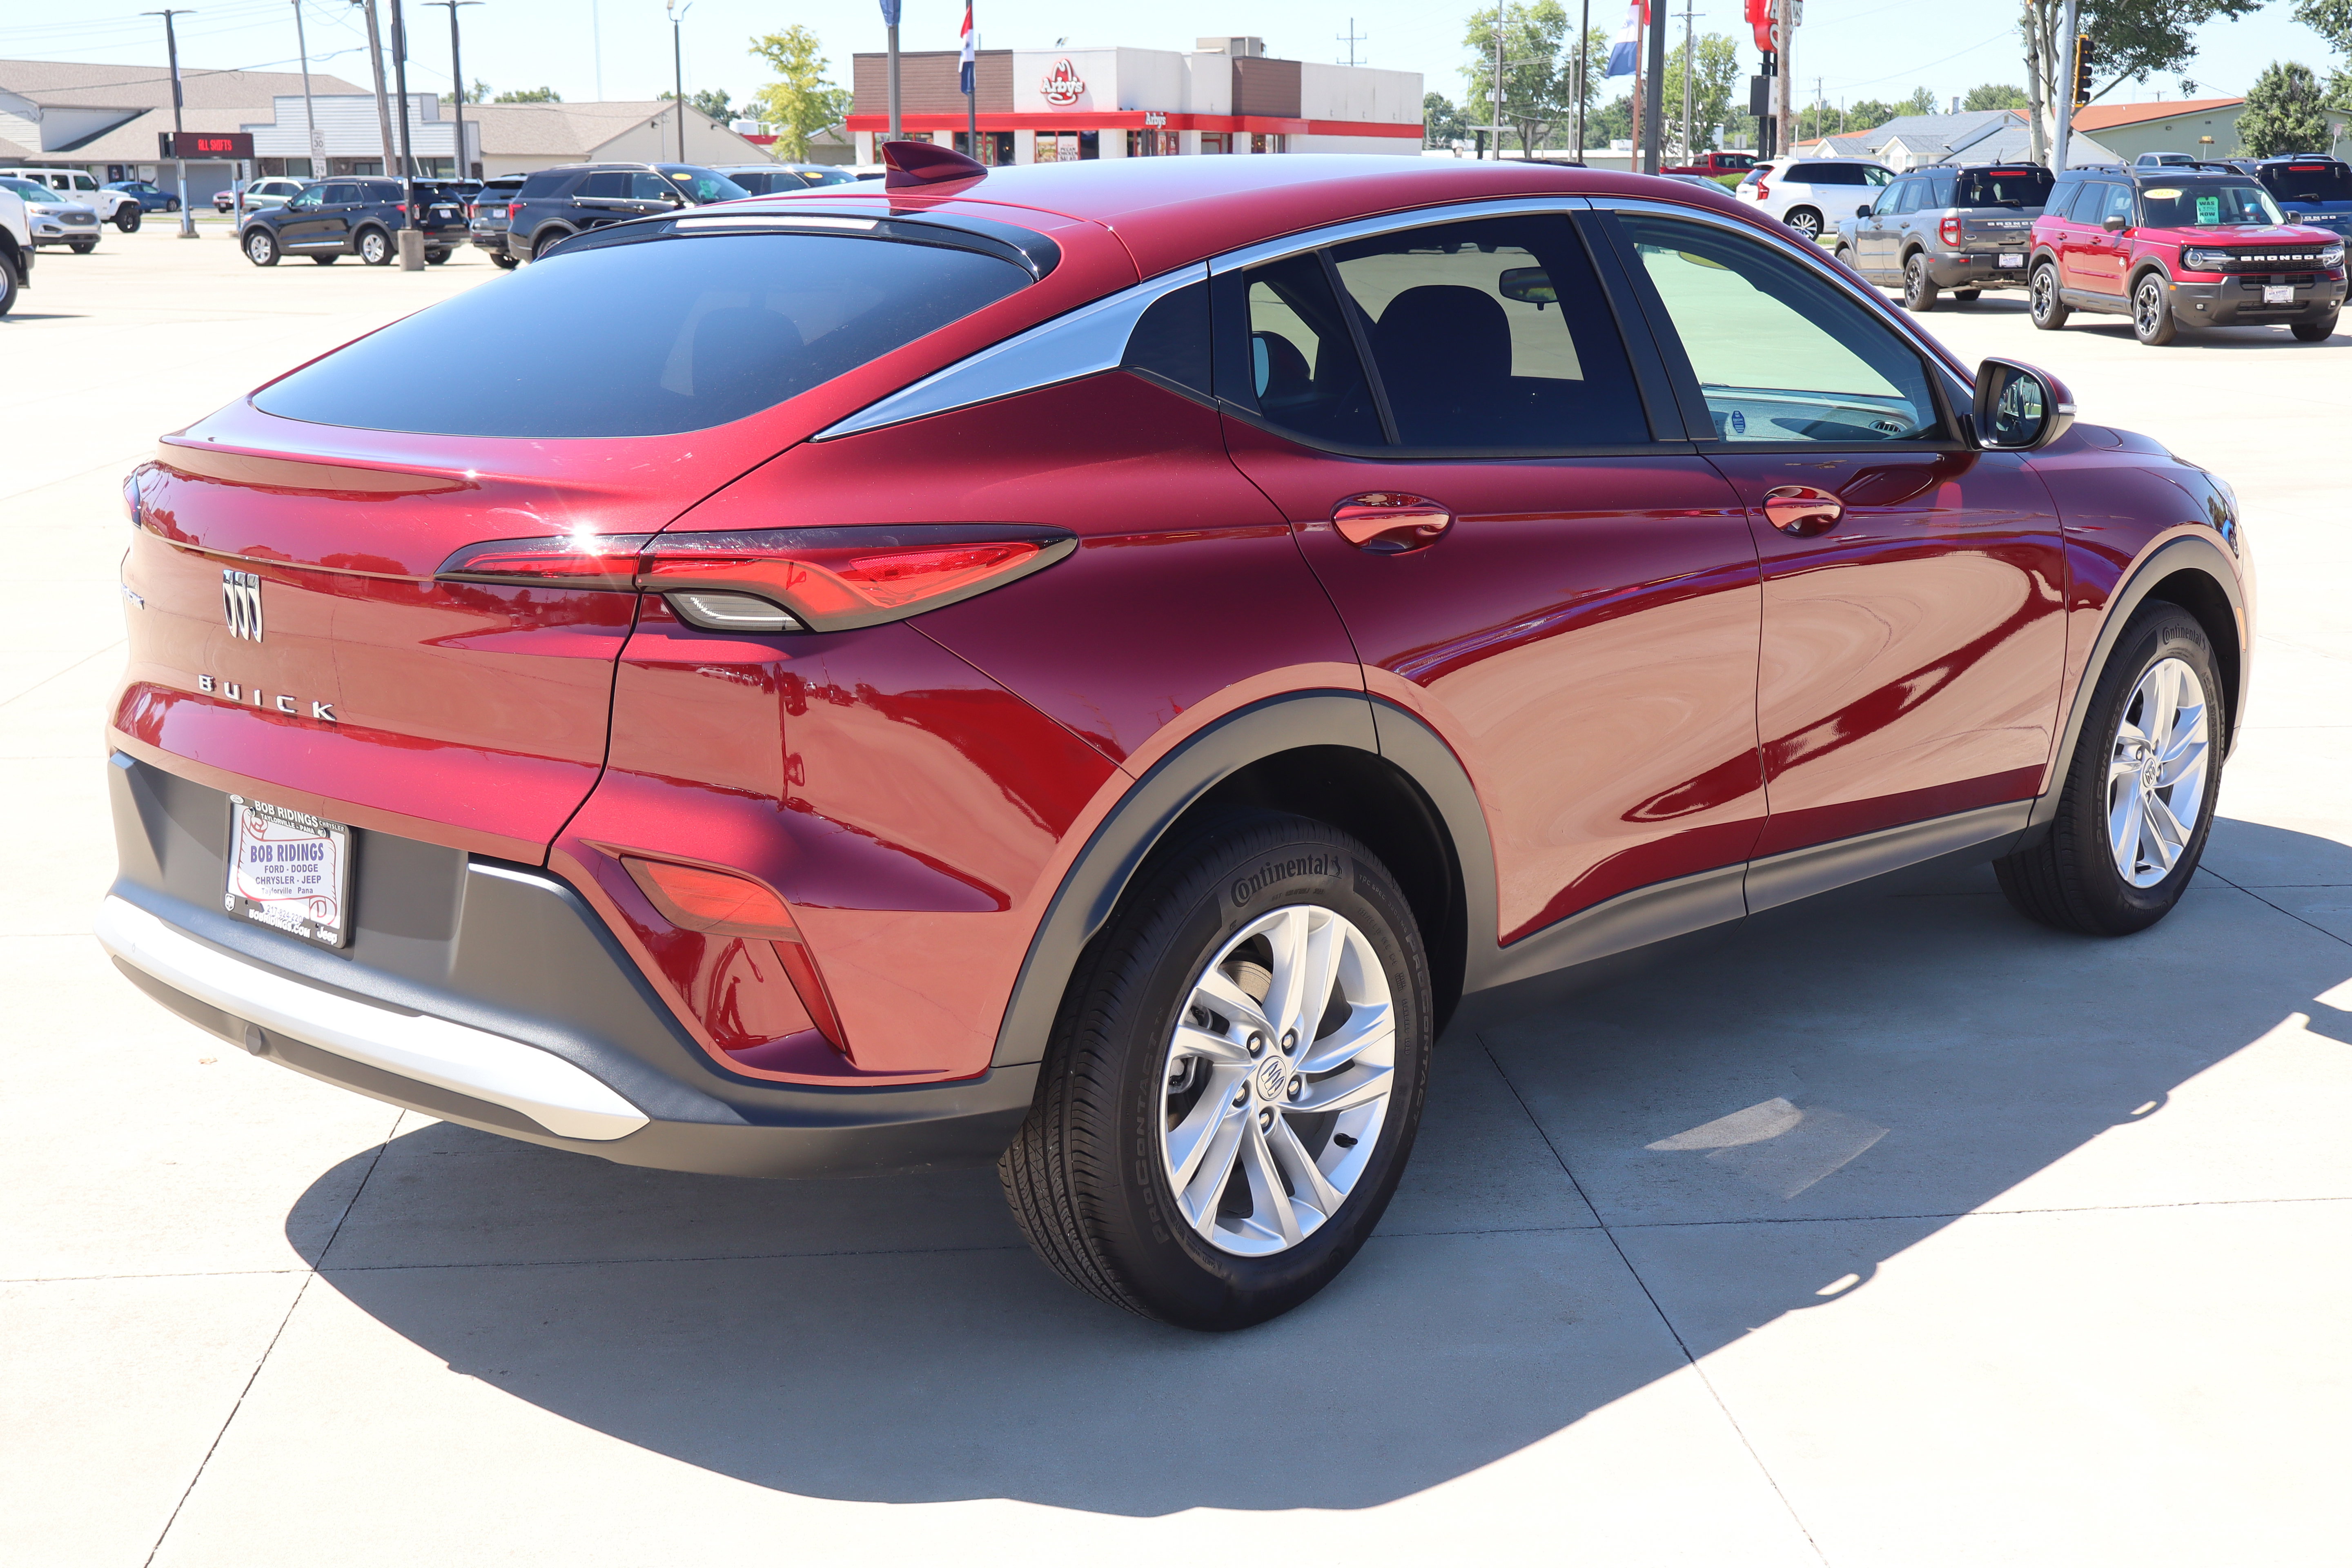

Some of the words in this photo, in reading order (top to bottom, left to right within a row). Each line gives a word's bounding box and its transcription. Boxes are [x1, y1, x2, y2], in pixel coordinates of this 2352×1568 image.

[1041, 76, 1083, 97] Arby's
[1145, 112, 1166, 129] Arby's
[198, 139, 209, 151] ALL
[210, 139, 232, 151] SHIFTS
[2163, 623, 2201, 648] Continental
[198, 674, 336, 721] BUICK
[255, 800, 275, 815] BOB
[277, 806, 318, 828] RIDINGS
[261, 813, 295, 829] TAYLORVILLE
[300, 825, 315, 834] PANA
[319, 820, 344, 832] CHRYSLER
[250, 845, 273, 863] BOB
[277, 842, 324, 862] RIDINGS
[265, 865, 284, 873] FORD
[291, 864, 318, 873] DODGE
[256, 876, 295, 885] CHRYSLER
[301, 875, 321, 884] JEEP
[1231, 853, 1328, 907] Continental
[1359, 874, 1371, 887] TPC
[1371, 882, 1387, 902] SPEC.
[262, 887, 292, 896] Taylorville
[249, 909, 311, 938] BOBRIDINGS.COM
[317, 926, 338, 945] Jeep
